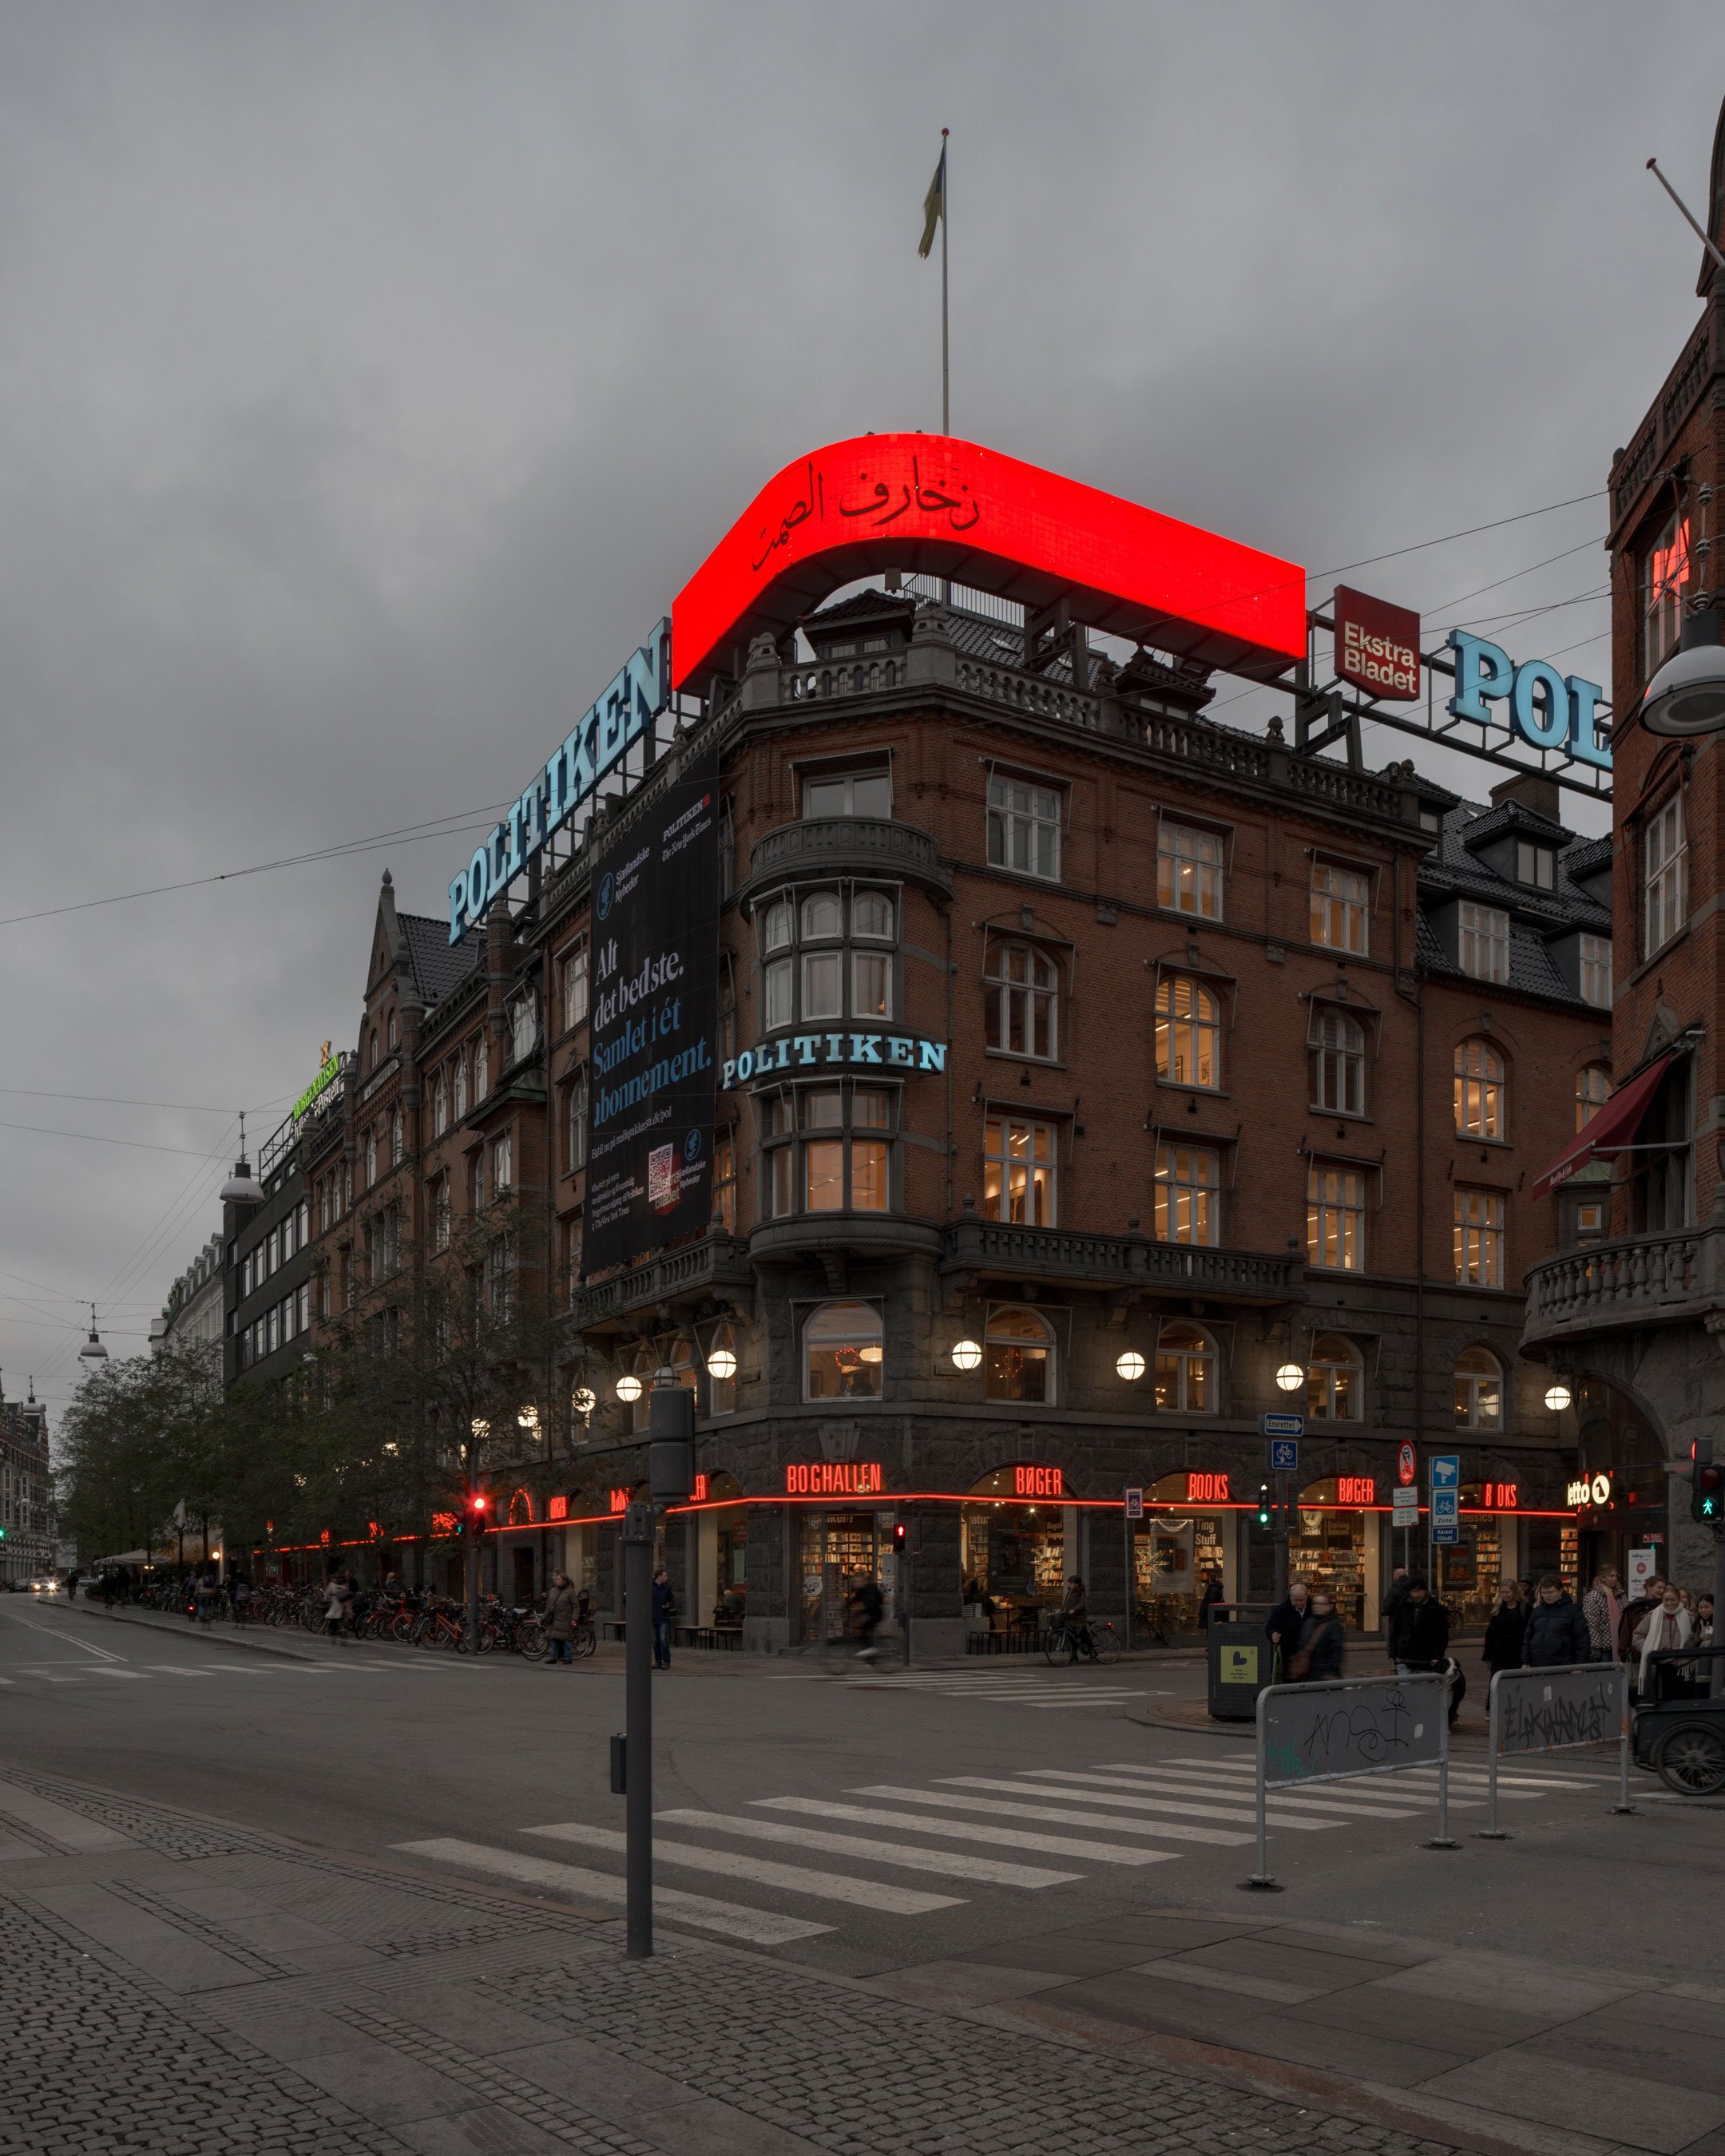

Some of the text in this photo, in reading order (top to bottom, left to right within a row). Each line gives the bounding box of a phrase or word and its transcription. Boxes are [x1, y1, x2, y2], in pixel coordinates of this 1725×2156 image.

[839, 454, 979, 530] زخارف
[1345, 621, 1416, 668] Ekstra
[1345, 647, 1416, 694] Bladet
[448, 616, 672, 947] POLITIKEN
[663, 799, 704, 842] POLITIKEN
[616, 847, 650, 886] Sjællandske
[615, 874, 639, 903] Nyheder
[595, 937, 618, 986] Alt
[594, 952, 684, 1032] det bedste.
[593, 997, 681, 1080] Samlet i ét
[723, 1034, 947, 1090] POLITIKEN
[680, 1175, 701, 1189] Nyheder
[1268, 1420, 1295, 1429] Ensrettet
[787, 1464, 881, 1493] BOGHALLEN
[1017, 1466, 1062, 1495] BØGER
[1188, 1474, 1227, 1500] BOOKS
[1339, 1477, 1374, 1503] BØGER
[1195, 1533, 1217, 1546] Stuff
